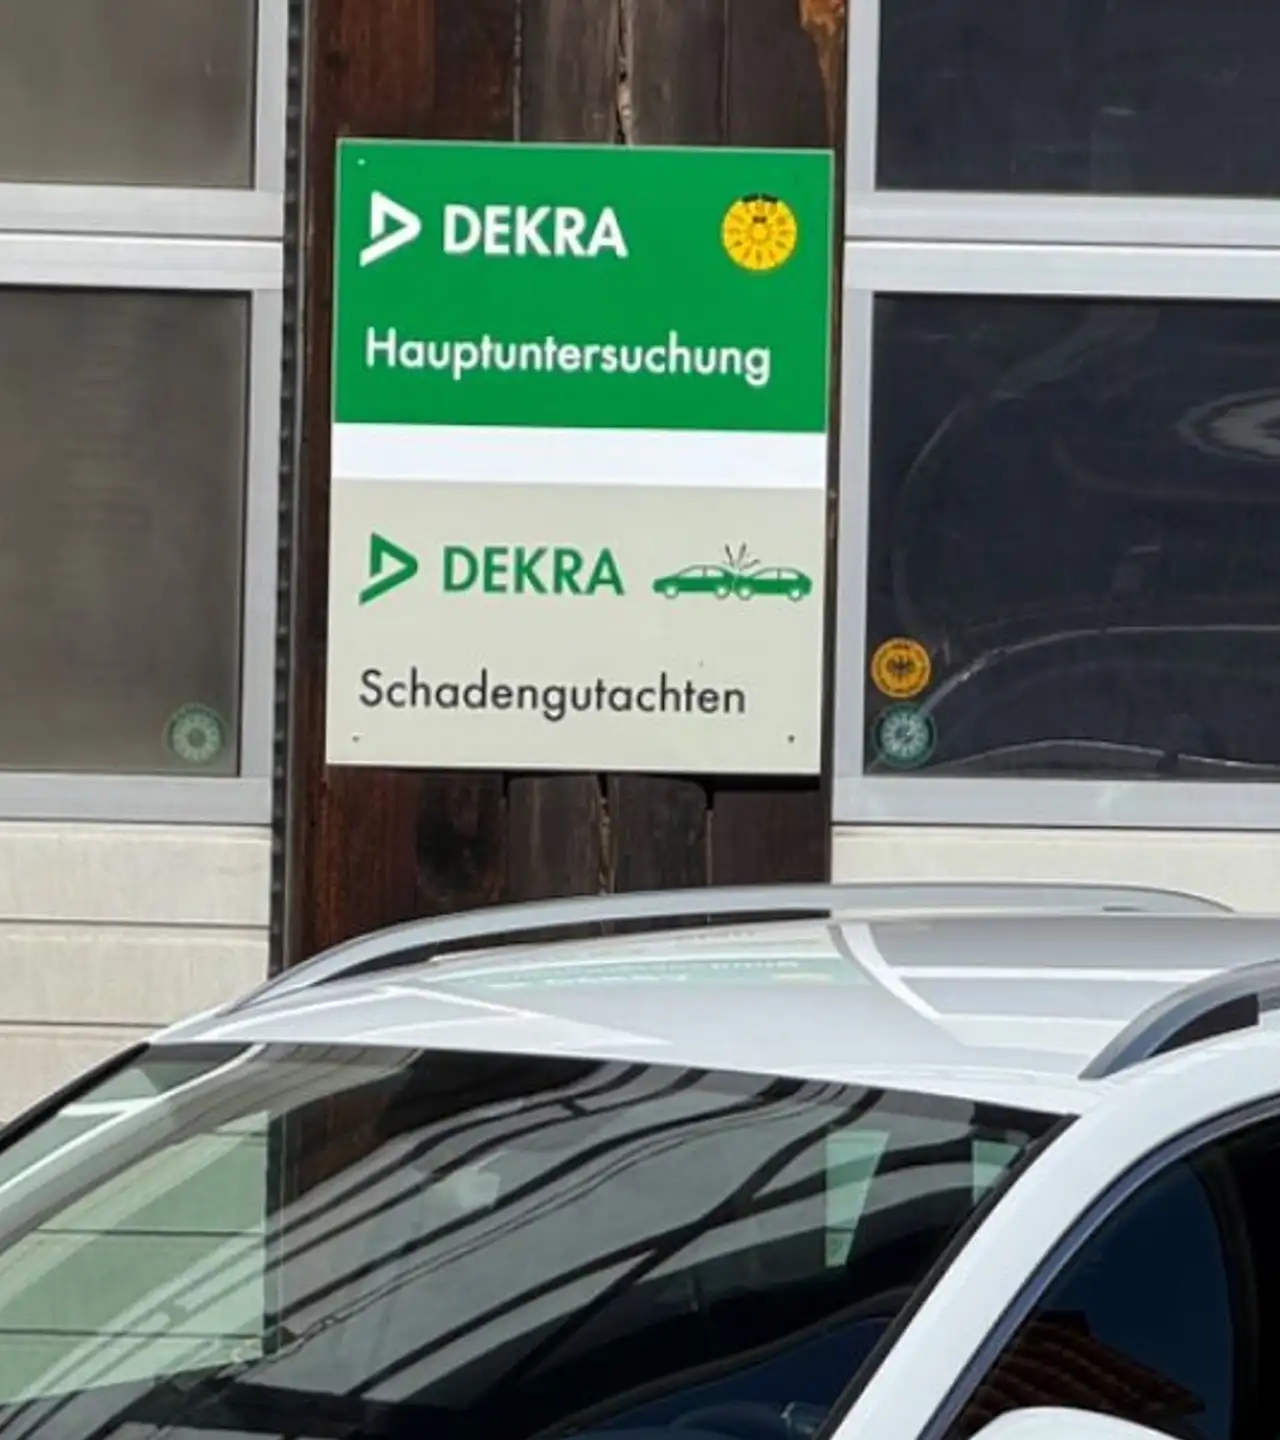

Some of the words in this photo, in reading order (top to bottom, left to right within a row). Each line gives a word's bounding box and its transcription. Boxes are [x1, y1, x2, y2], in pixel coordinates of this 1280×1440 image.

[443, 204, 628, 258] DEKRA
[366, 327, 771, 388] Hauptuntersuchung
[443, 546, 624, 596] DEKRA
[359, 668, 747, 722] Schadengutachten
